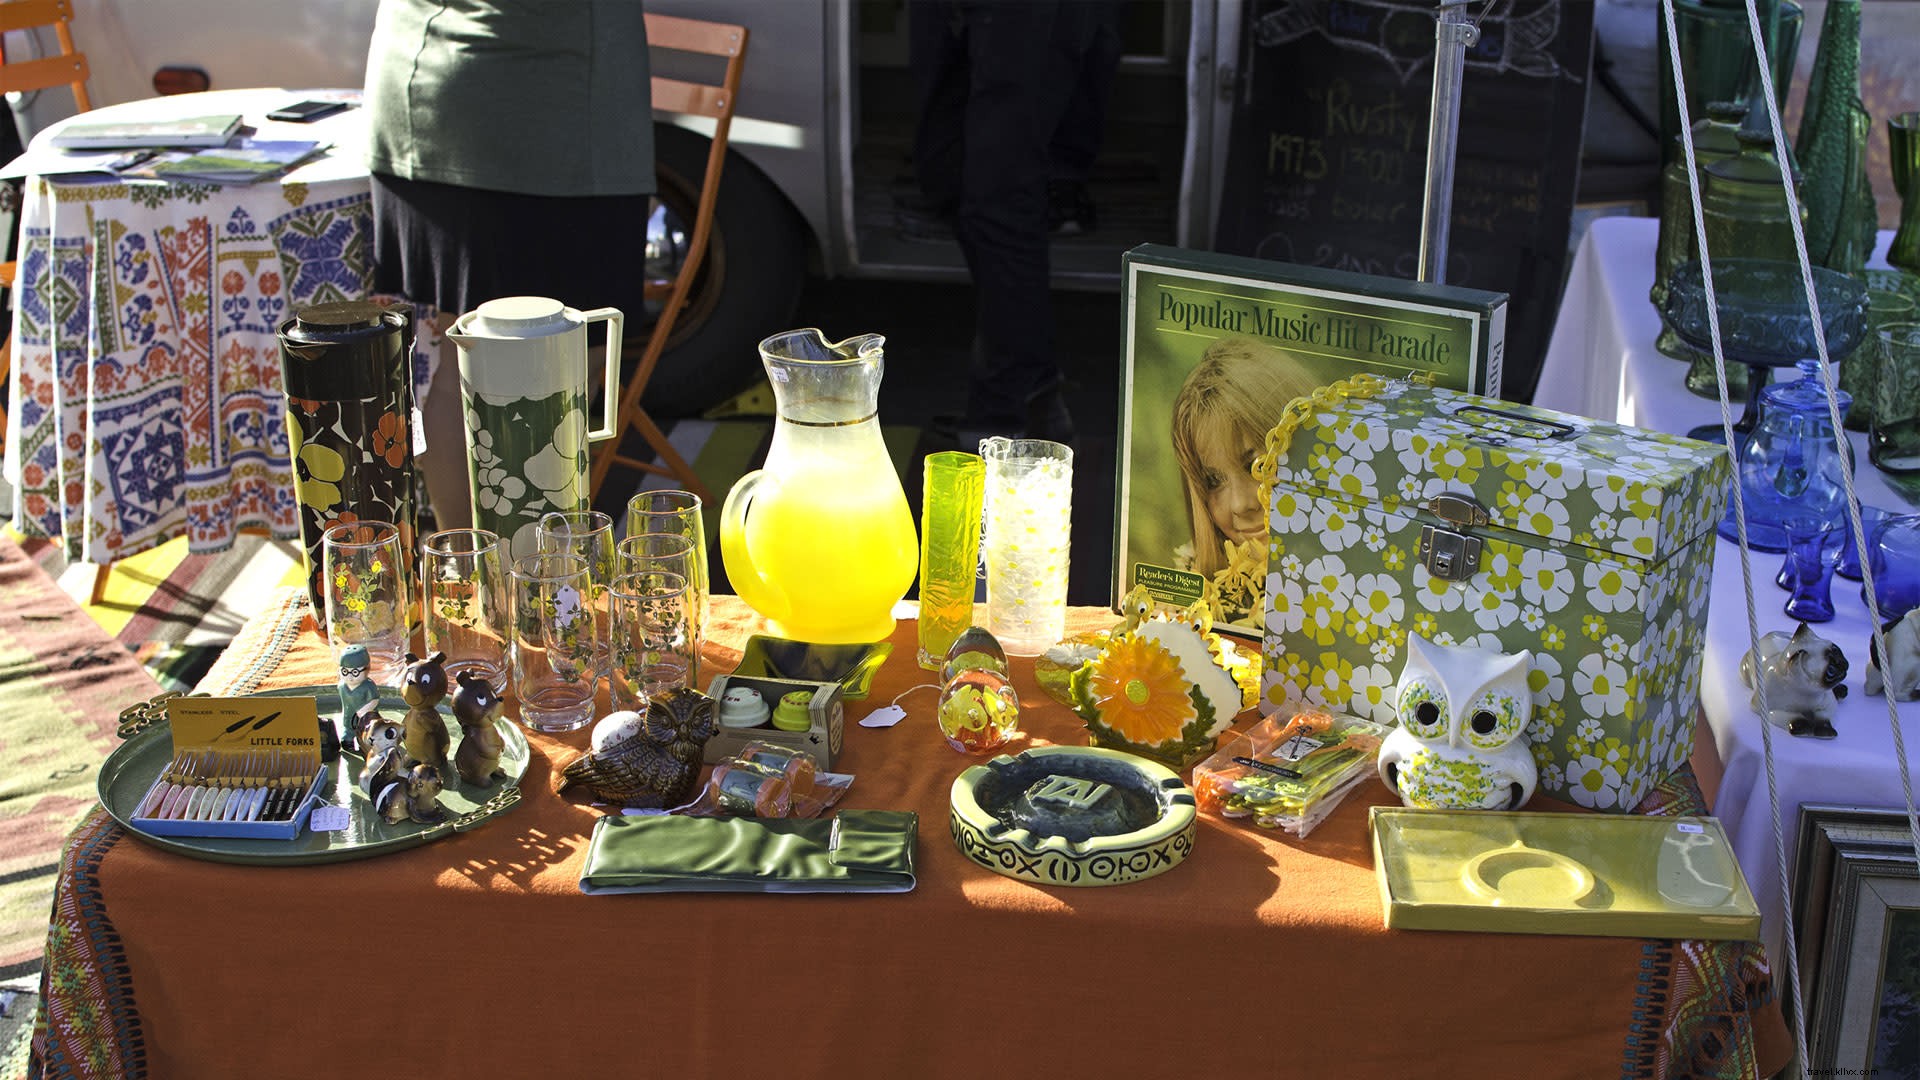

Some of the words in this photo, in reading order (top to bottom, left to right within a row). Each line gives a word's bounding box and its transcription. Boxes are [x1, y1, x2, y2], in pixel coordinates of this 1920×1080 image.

[1267, 132, 1328, 180] 1973
[1156, 291, 1249, 333] Popular
[1249, 305, 1322, 345] Music
[1325, 315, 1362, 351] Hit
[1368, 324, 1451, 366] Parade
[1139, 567, 1174, 582] Reader's
[1175, 574, 1200, 587] Digest
[250, 737, 283, 746] LITTLE
[286, 737, 315, 746] FORKS
